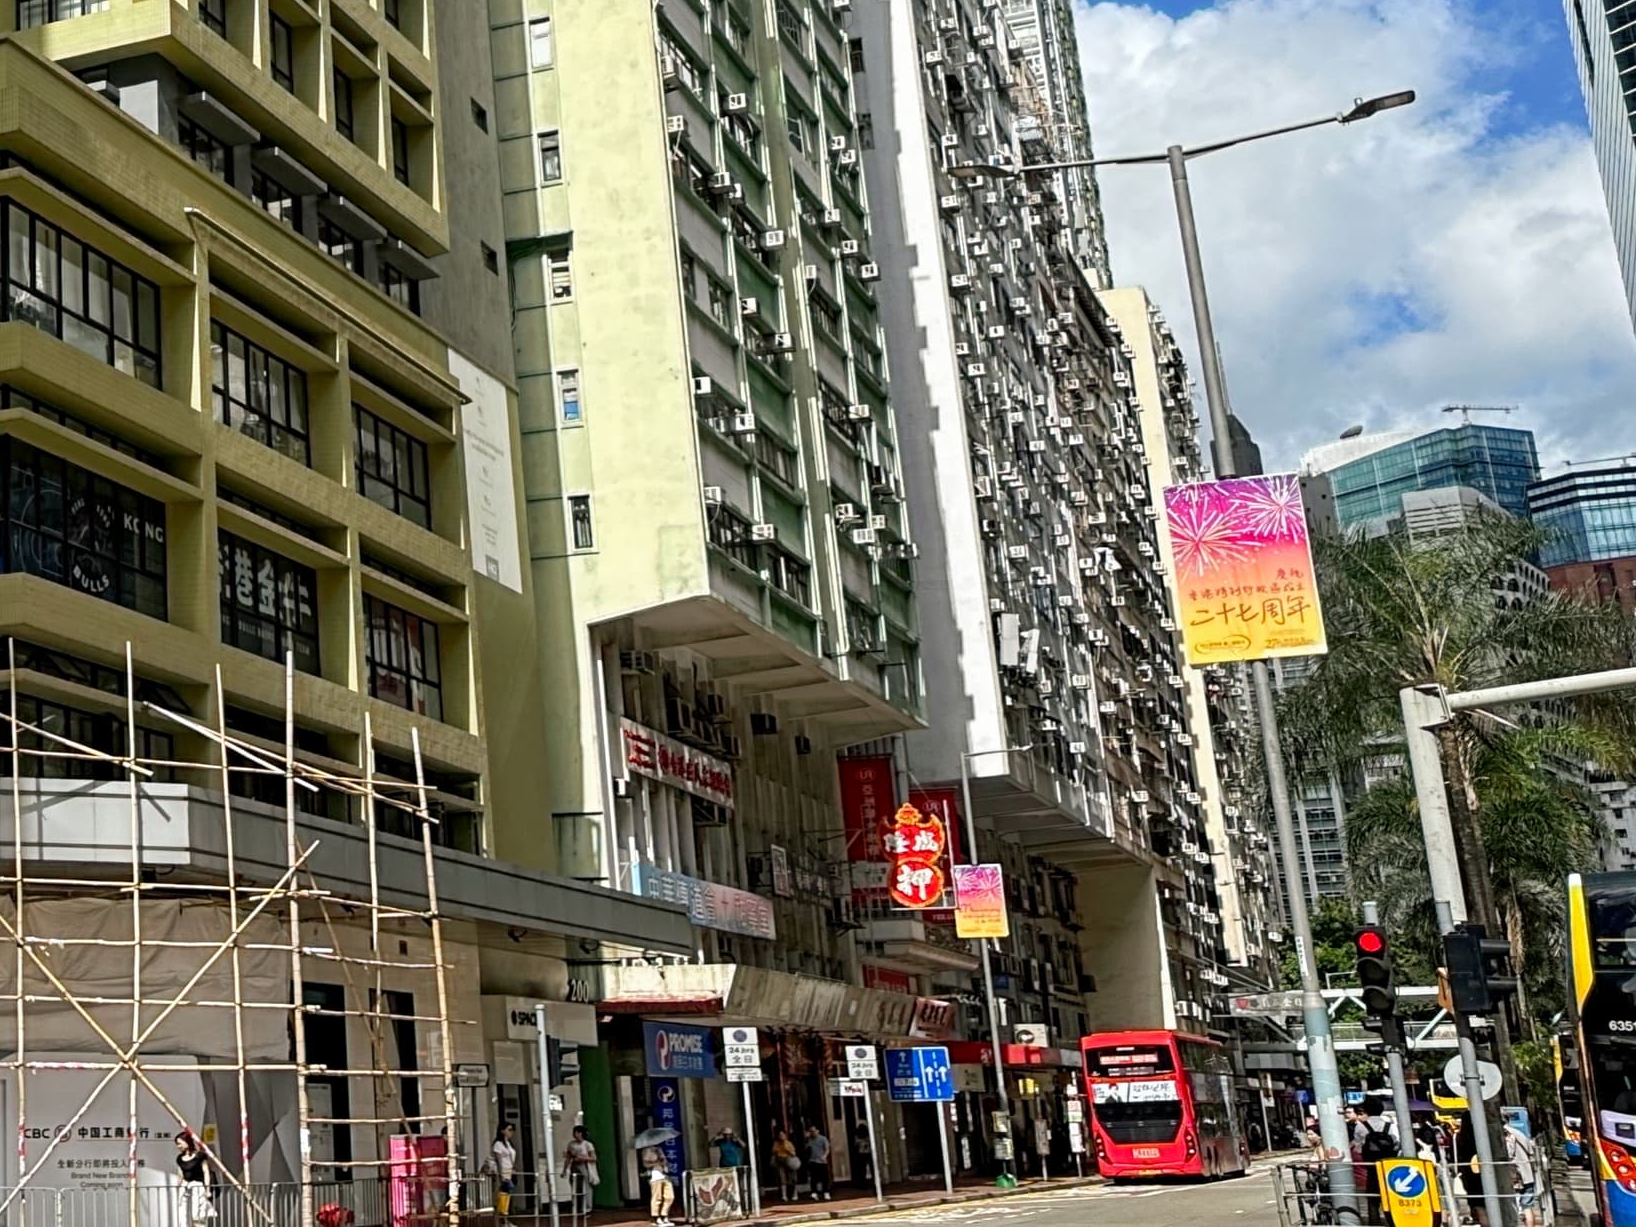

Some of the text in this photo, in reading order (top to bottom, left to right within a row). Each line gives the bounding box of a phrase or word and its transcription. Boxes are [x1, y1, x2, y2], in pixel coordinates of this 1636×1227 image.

[72, 564, 110, 593] BULLS
[1190, 595, 1311, 627] 二十七周年
[897, 864, 933, 900] 押
[571, 979, 589, 1002] 200
[668, 1032, 703, 1054] PROMISE
[728, 1046, 740, 1054] 24
[732, 1055, 753, 1063] 全日
[22, 1127, 50, 1139] CBC
[57, 1159, 146, 1169] 全新分行即將投入務
[70, 1172, 90, 1180] Brand
[92, 1172, 107, 1180] New
[80, 1181, 103, 1190] Coming
